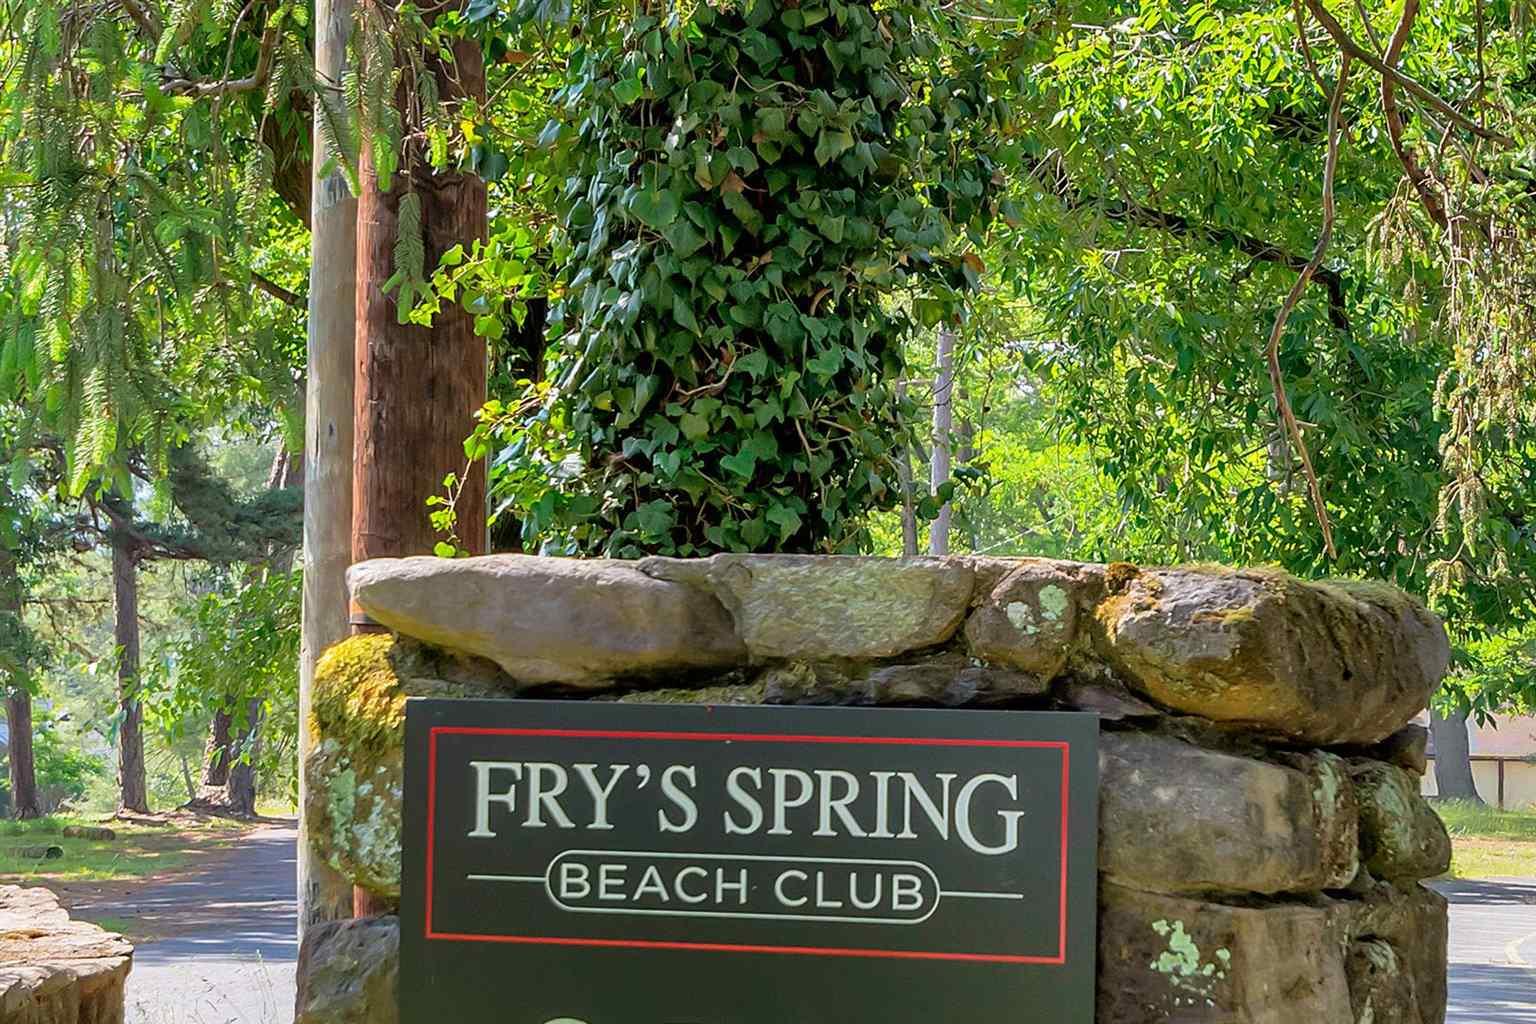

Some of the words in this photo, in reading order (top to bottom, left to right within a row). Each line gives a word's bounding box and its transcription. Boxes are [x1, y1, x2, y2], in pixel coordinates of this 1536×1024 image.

[467, 761, 698, 837] FRY'S
[723, 766, 1025, 855] SPRING
[559, 862, 748, 905] BEACH
[774, 869, 924, 910] CLUB
